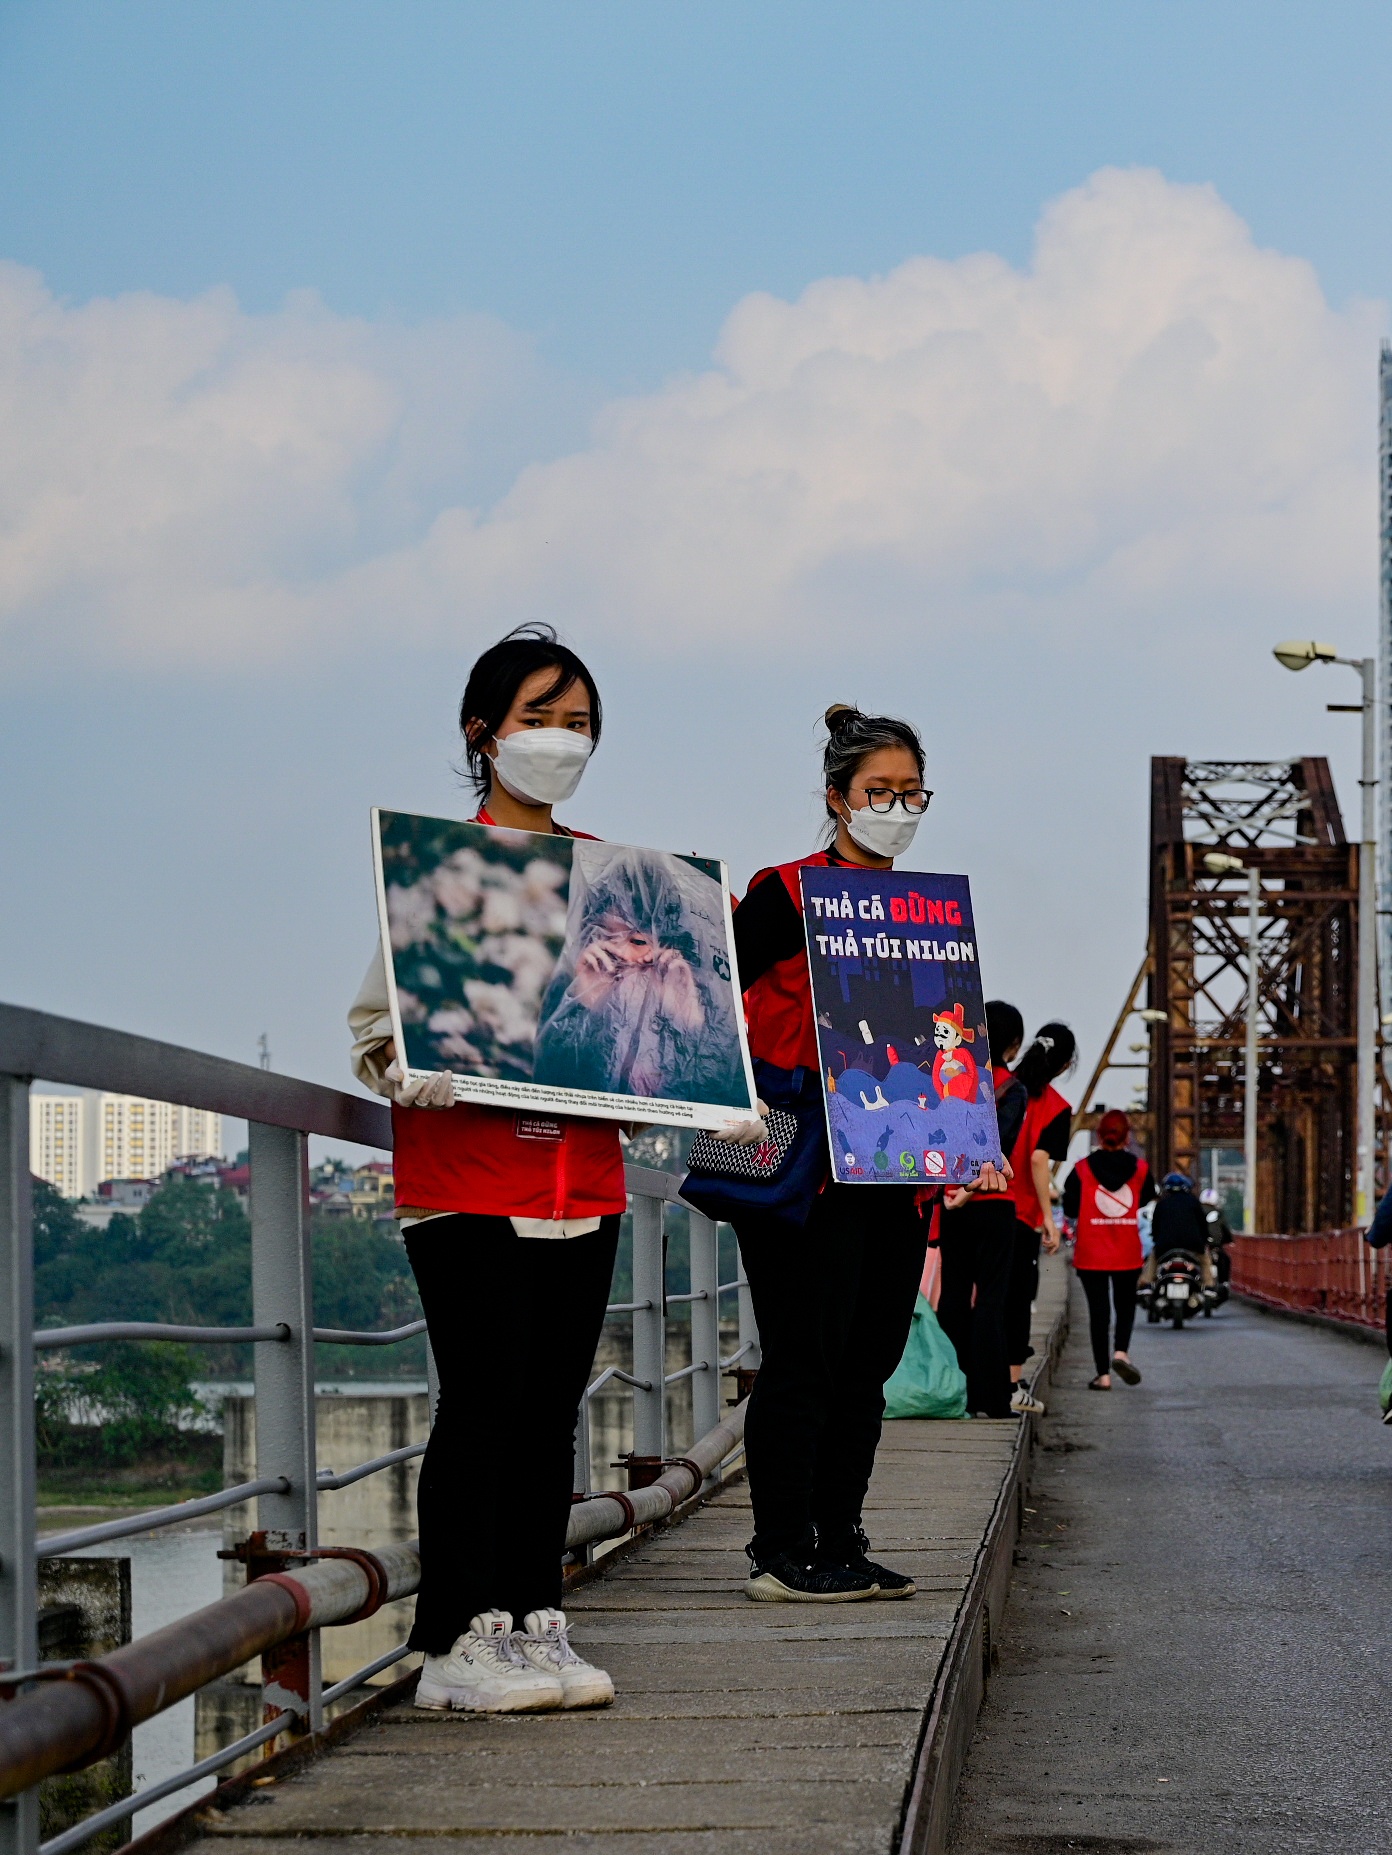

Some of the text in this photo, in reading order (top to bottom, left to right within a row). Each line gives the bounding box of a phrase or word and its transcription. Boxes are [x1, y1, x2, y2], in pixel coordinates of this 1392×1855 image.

[810, 890, 962, 926] THẢ CÁ ĐỪNG
[816, 929, 976, 962] THẢ TÚI NILON
[840, 1166, 864, 1175] USAID
[460, 1650, 474, 1666] FILA
